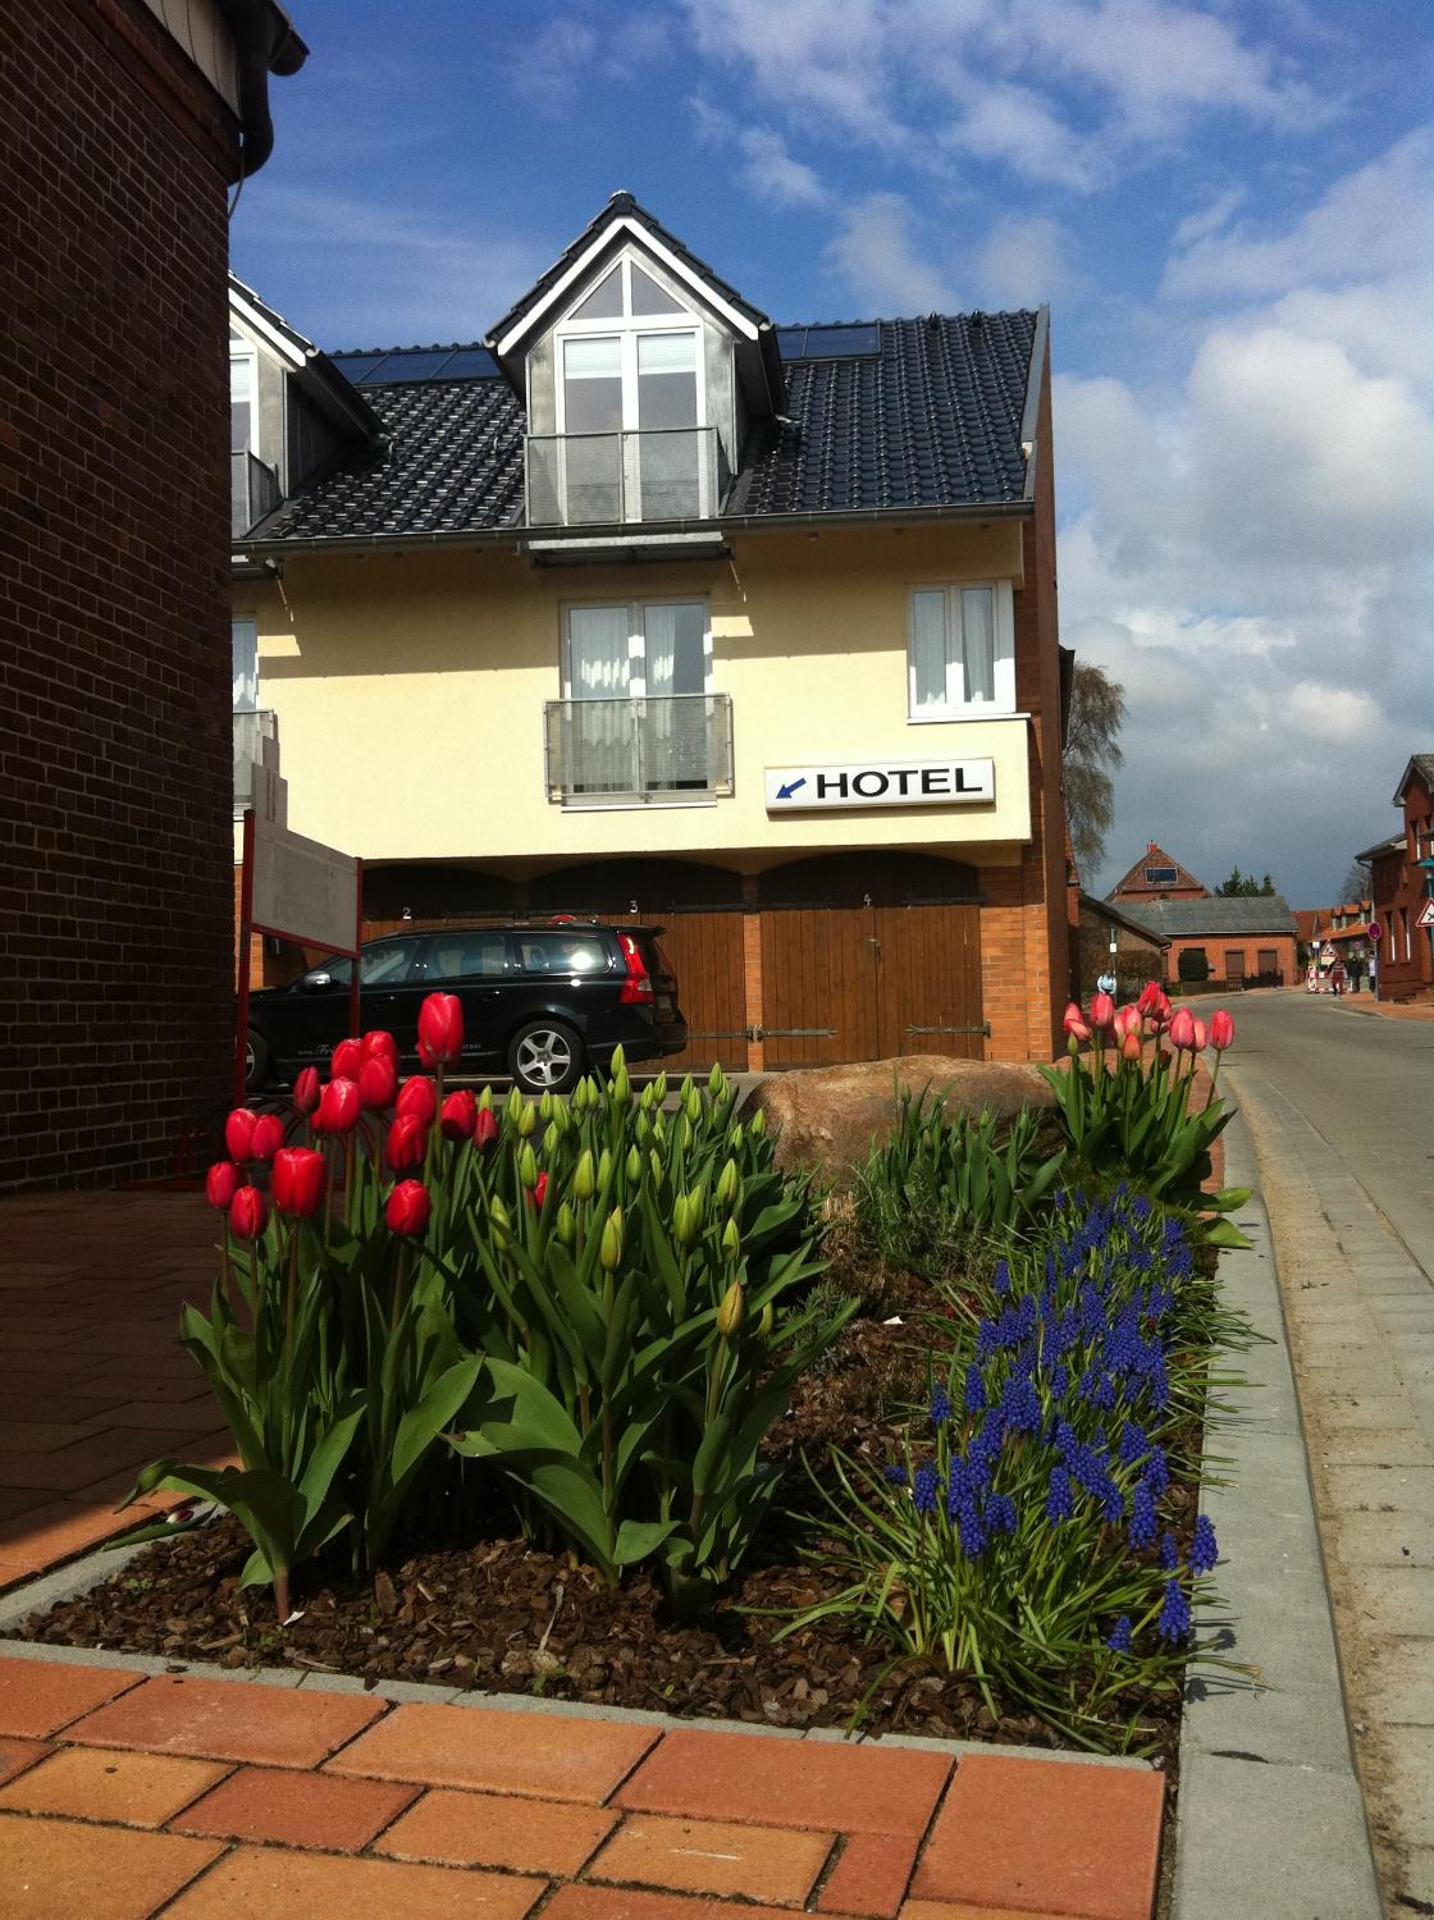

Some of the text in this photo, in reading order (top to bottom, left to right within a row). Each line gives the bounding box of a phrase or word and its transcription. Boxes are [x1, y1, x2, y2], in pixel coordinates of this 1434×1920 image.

[817, 768, 983, 799] HOTEL
[630, 900, 639, 914] 3
[863, 893, 873, 907] 4
[402, 906, 412, 920] 2
